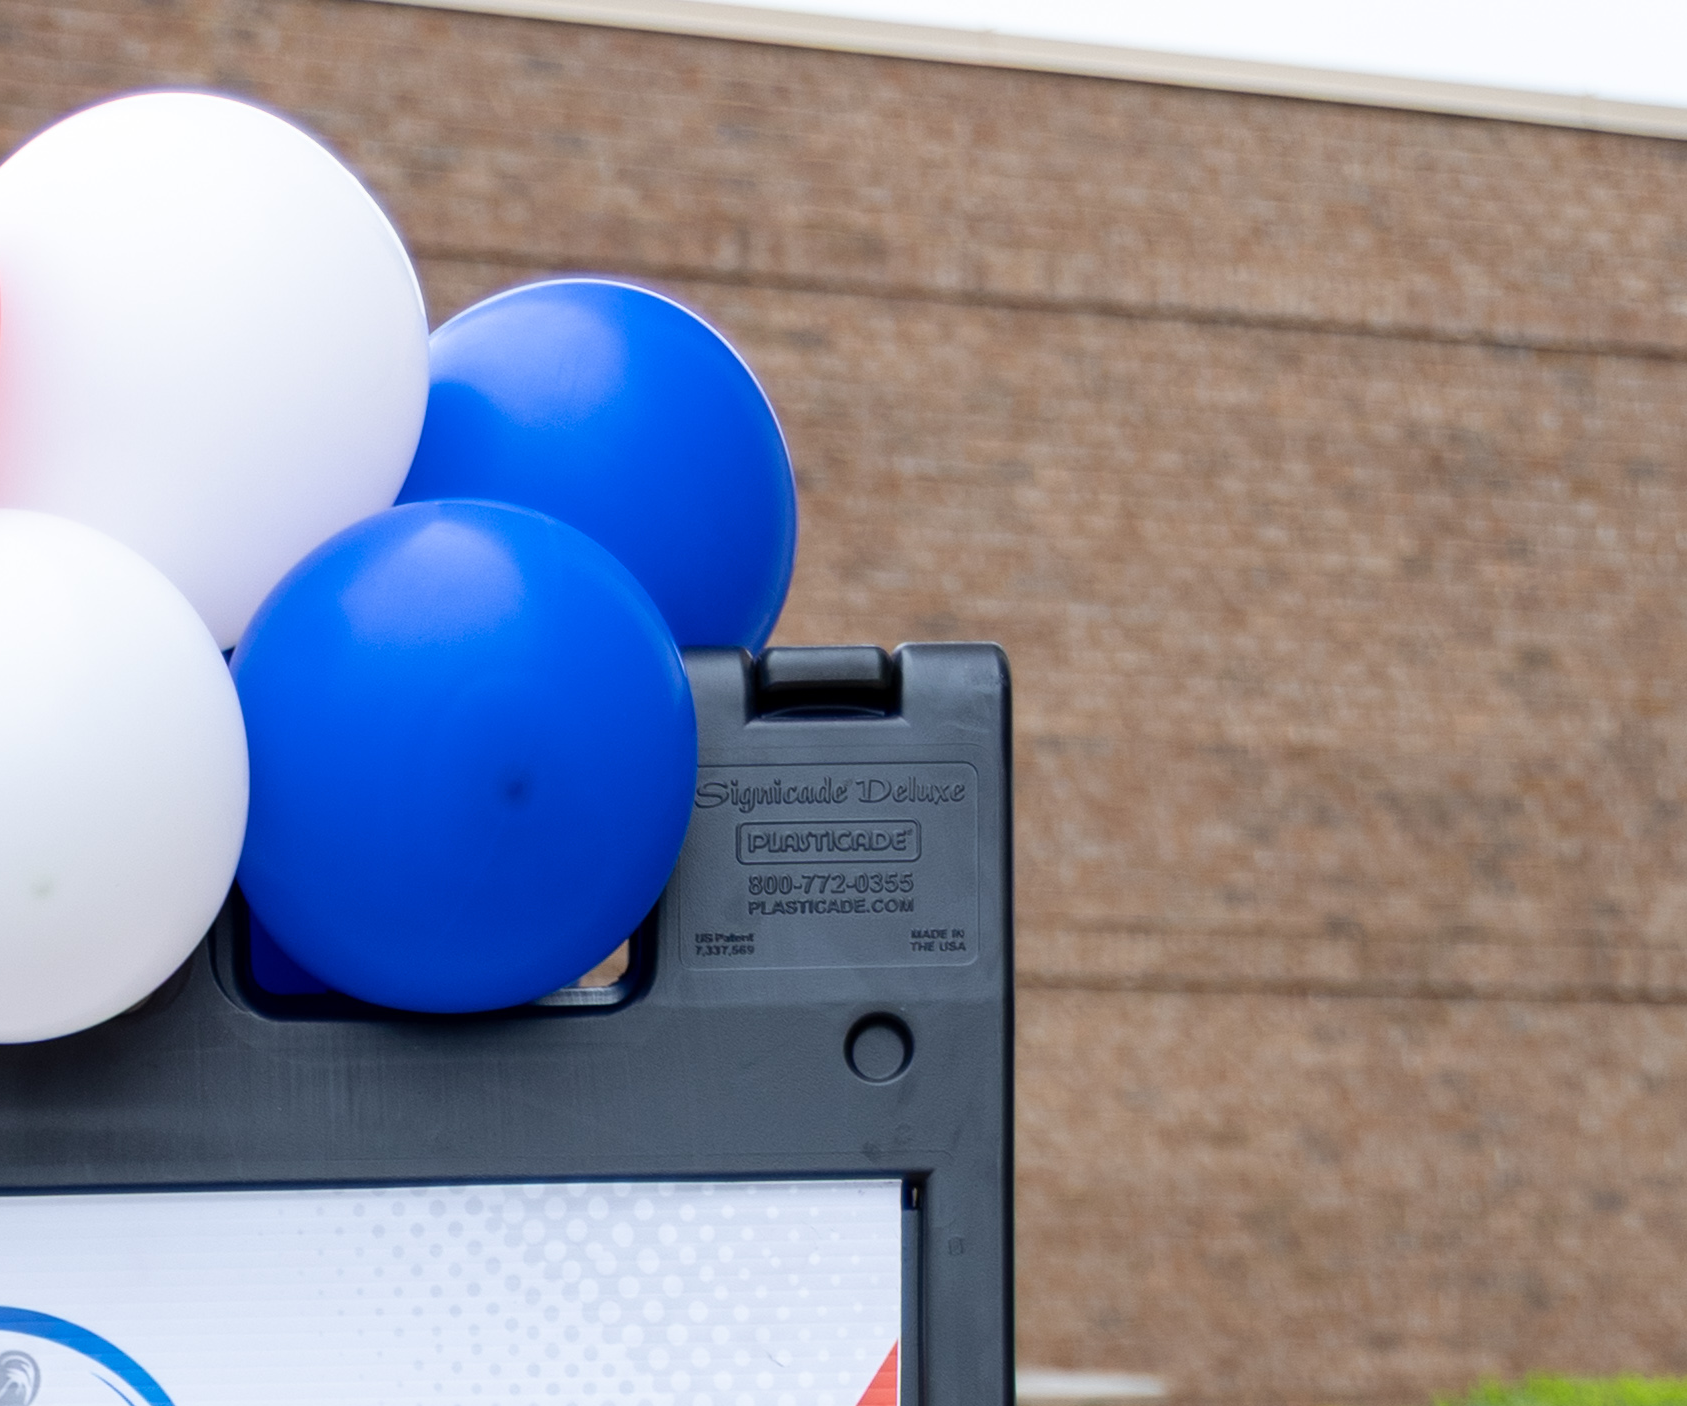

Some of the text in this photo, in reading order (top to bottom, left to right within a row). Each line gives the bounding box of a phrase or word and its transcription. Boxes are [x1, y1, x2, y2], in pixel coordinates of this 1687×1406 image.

[695, 776, 966, 813] Signicade Deluxe
[748, 830, 907, 854] PLASTICADE
[748, 872, 914, 895] 800-772-0355
[748, 898, 914, 916] PLASTICADE.COM
[695, 932, 755, 944] US Patent
[910, 928, 965, 939] MADE IN
[910, 941, 966, 952] THE USA
